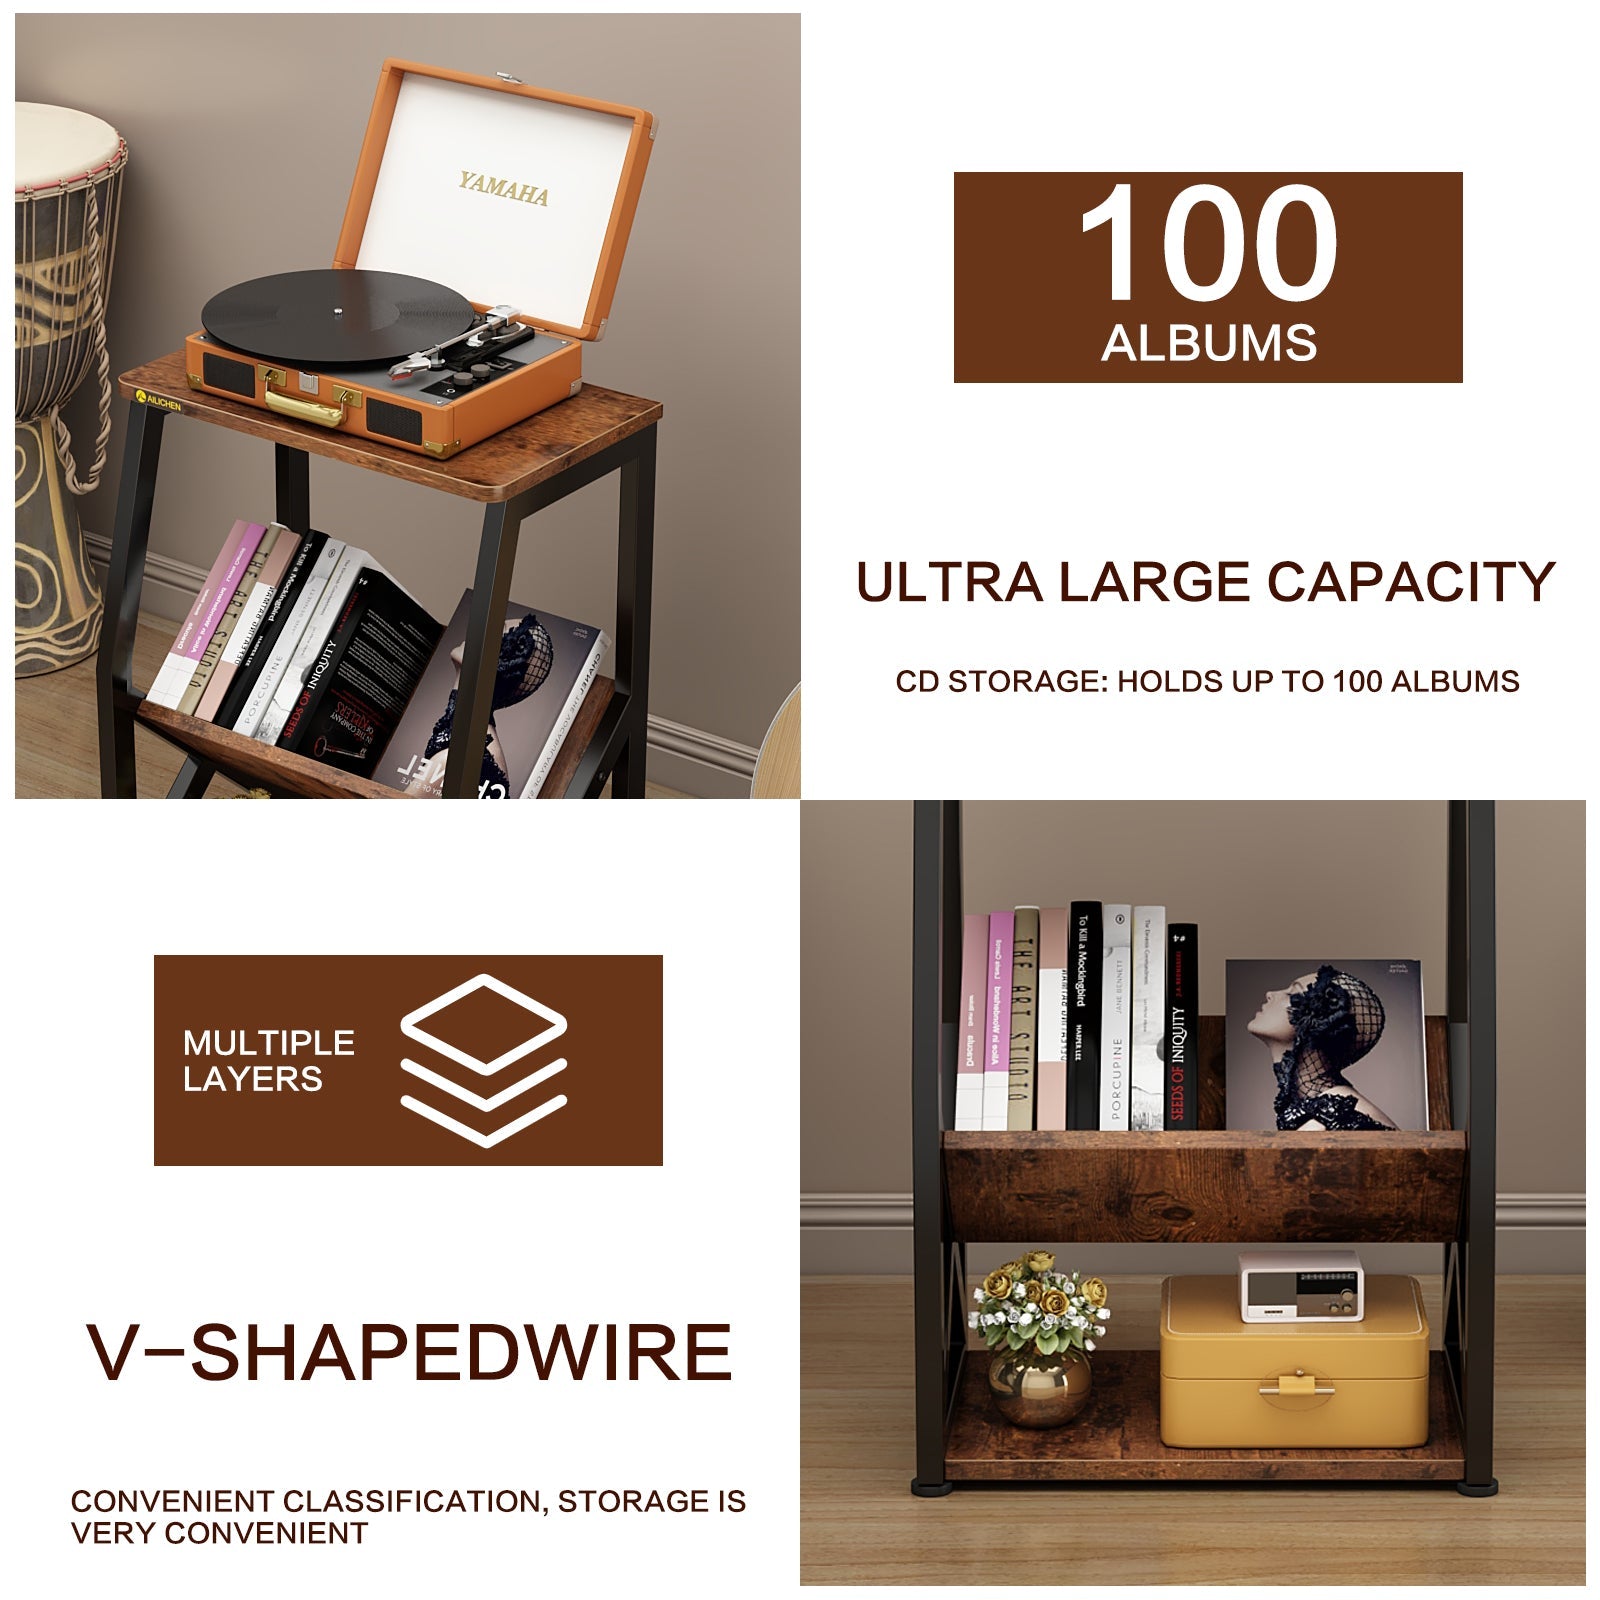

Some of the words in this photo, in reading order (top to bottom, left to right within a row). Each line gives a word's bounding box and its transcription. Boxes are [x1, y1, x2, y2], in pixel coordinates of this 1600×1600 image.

[459, 170, 548, 207] YAMAHA
[147, 395, 181, 411] AILICHEN
[298, 553, 307, 567] Kill
[303, 543, 313, 552] To
[245, 551, 269, 578] THE
[224, 590, 247, 619] ART
[268, 573, 297, 622] Mockingbird
[189, 630, 227, 688] STUDIO
[244, 655, 283, 725] PORCUPINE
[284, 707, 305, 739] SEEDS
[300, 690, 312, 706] OF
[307, 640, 337, 690] INIQUITY
[1079, 914, 1088, 926] To
[1079, 928, 1088, 942] Kill
[1013, 938, 1033, 968] THE
[1075, 951, 1087, 1007] Mockingbird
[1011, 985, 1032, 1016] ART
[1172, 1007, 1188, 1063] INIQUITY
[1009, 1032, 1030, 1101] STUDIO
[1111, 1038, 1122, 1120] PORCUPINE
[1171, 1066, 1184, 1083] OF
[1171, 1085, 1184, 1120] SEEDS
